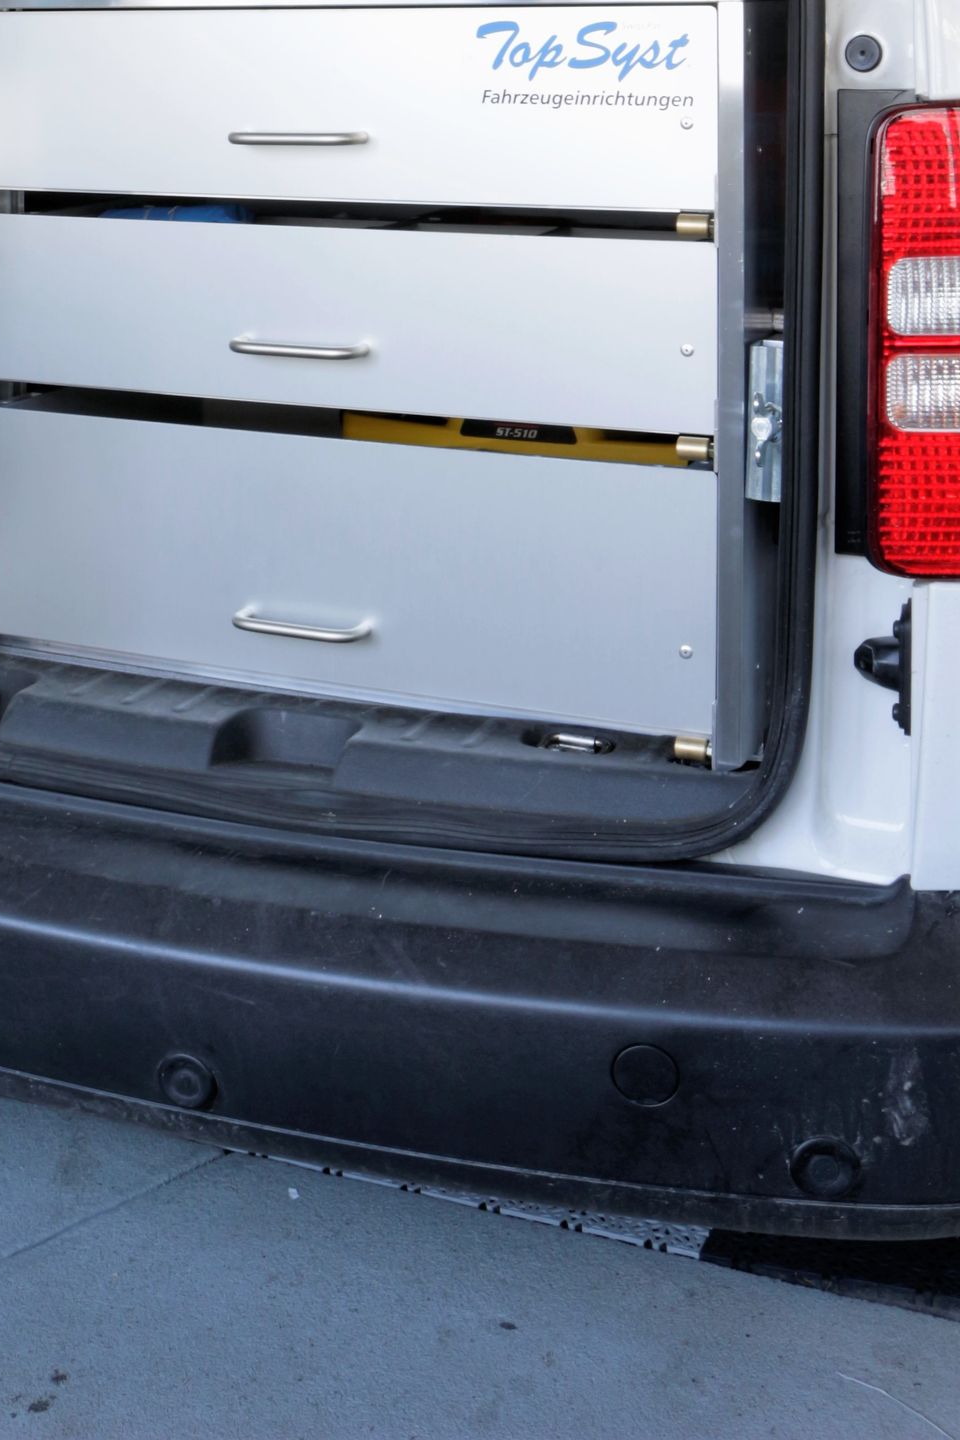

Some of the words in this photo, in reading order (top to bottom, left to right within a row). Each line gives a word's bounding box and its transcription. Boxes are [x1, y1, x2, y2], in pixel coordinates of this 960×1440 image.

[476, 20, 690, 82] TopSyst
[481, 89, 694, 111] Fahrzeugeinrichtungen
[495, 426, 539, 439] ST-510
